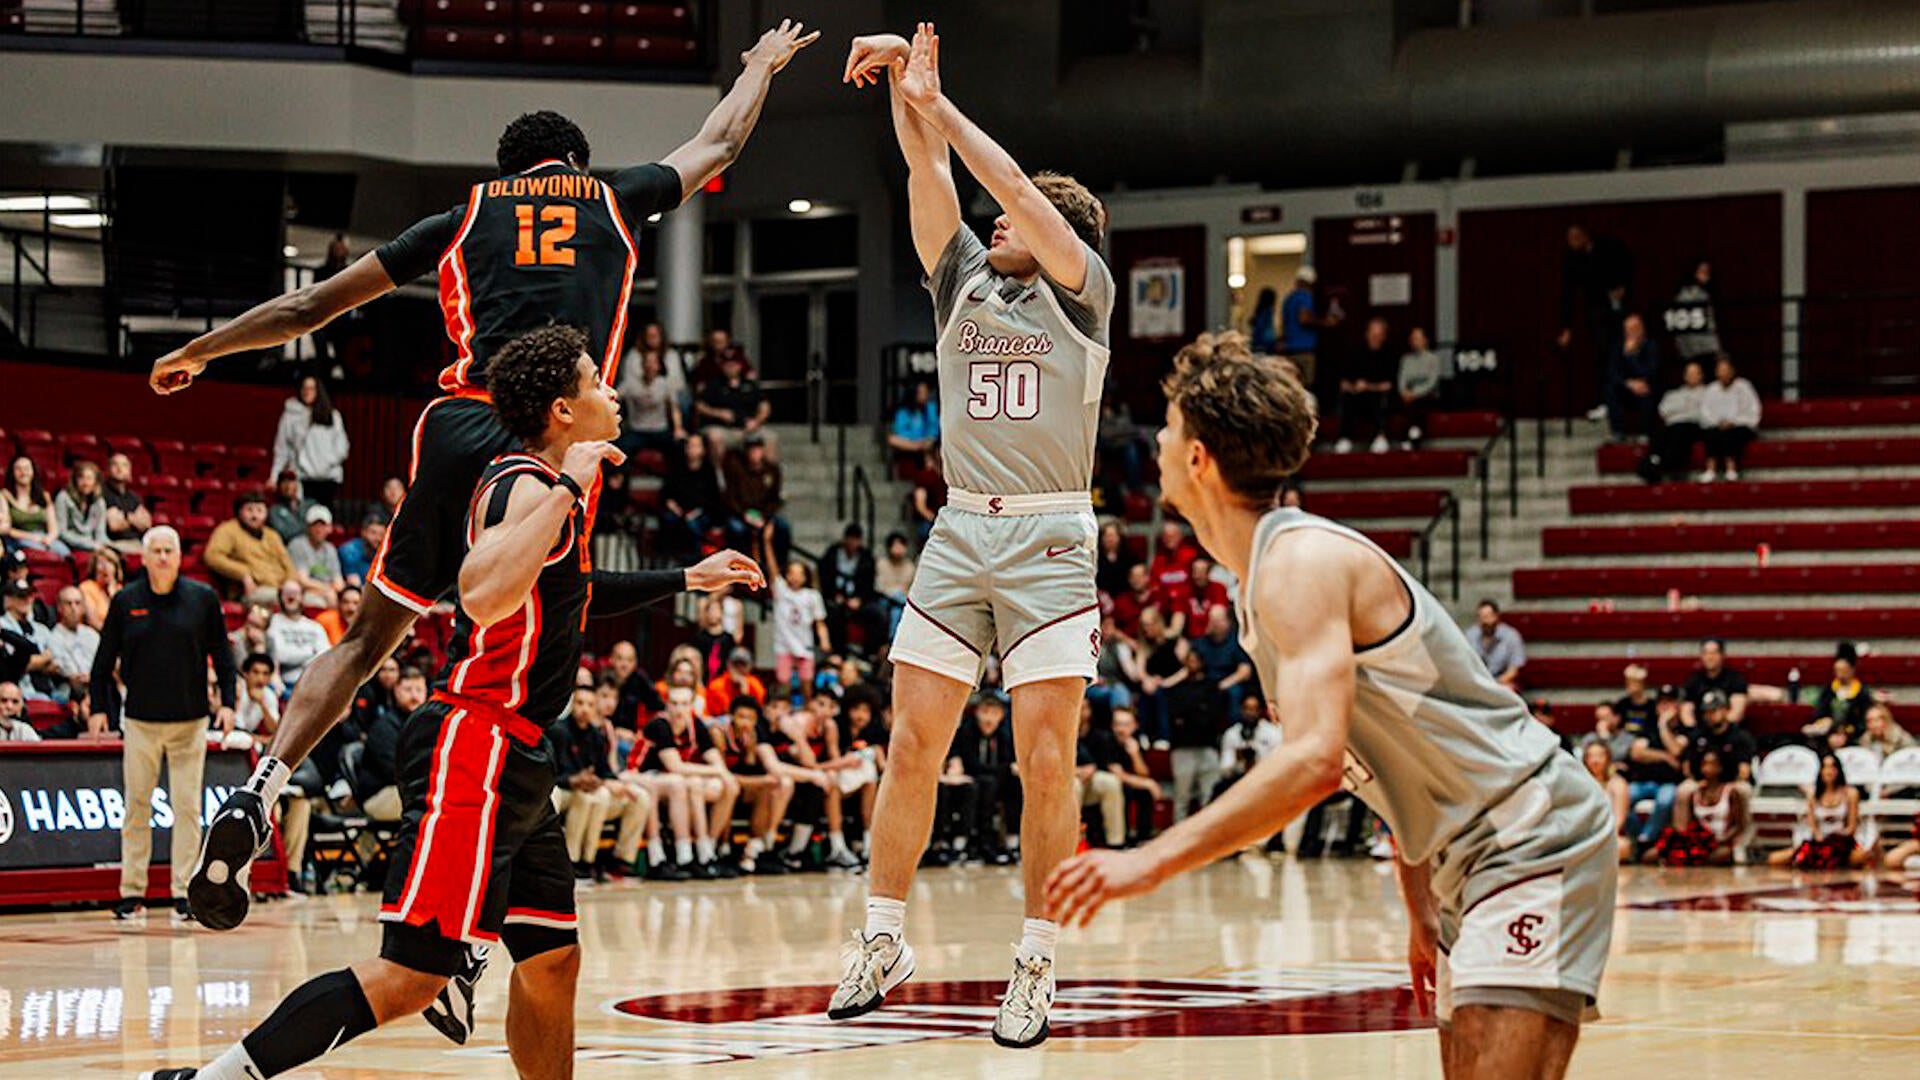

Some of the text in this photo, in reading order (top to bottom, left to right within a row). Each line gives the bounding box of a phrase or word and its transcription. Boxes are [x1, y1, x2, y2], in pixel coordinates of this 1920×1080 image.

[487, 174, 600, 200] OLOWONIYI
[515, 204, 577, 267] 12
[1664, 307, 1706, 331] 105
[957, 320, 1054, 355] Broncos
[1457, 350, 1497, 371] 104
[967, 361, 1040, 420] 50
[21, 787, 175, 832] HABBS
